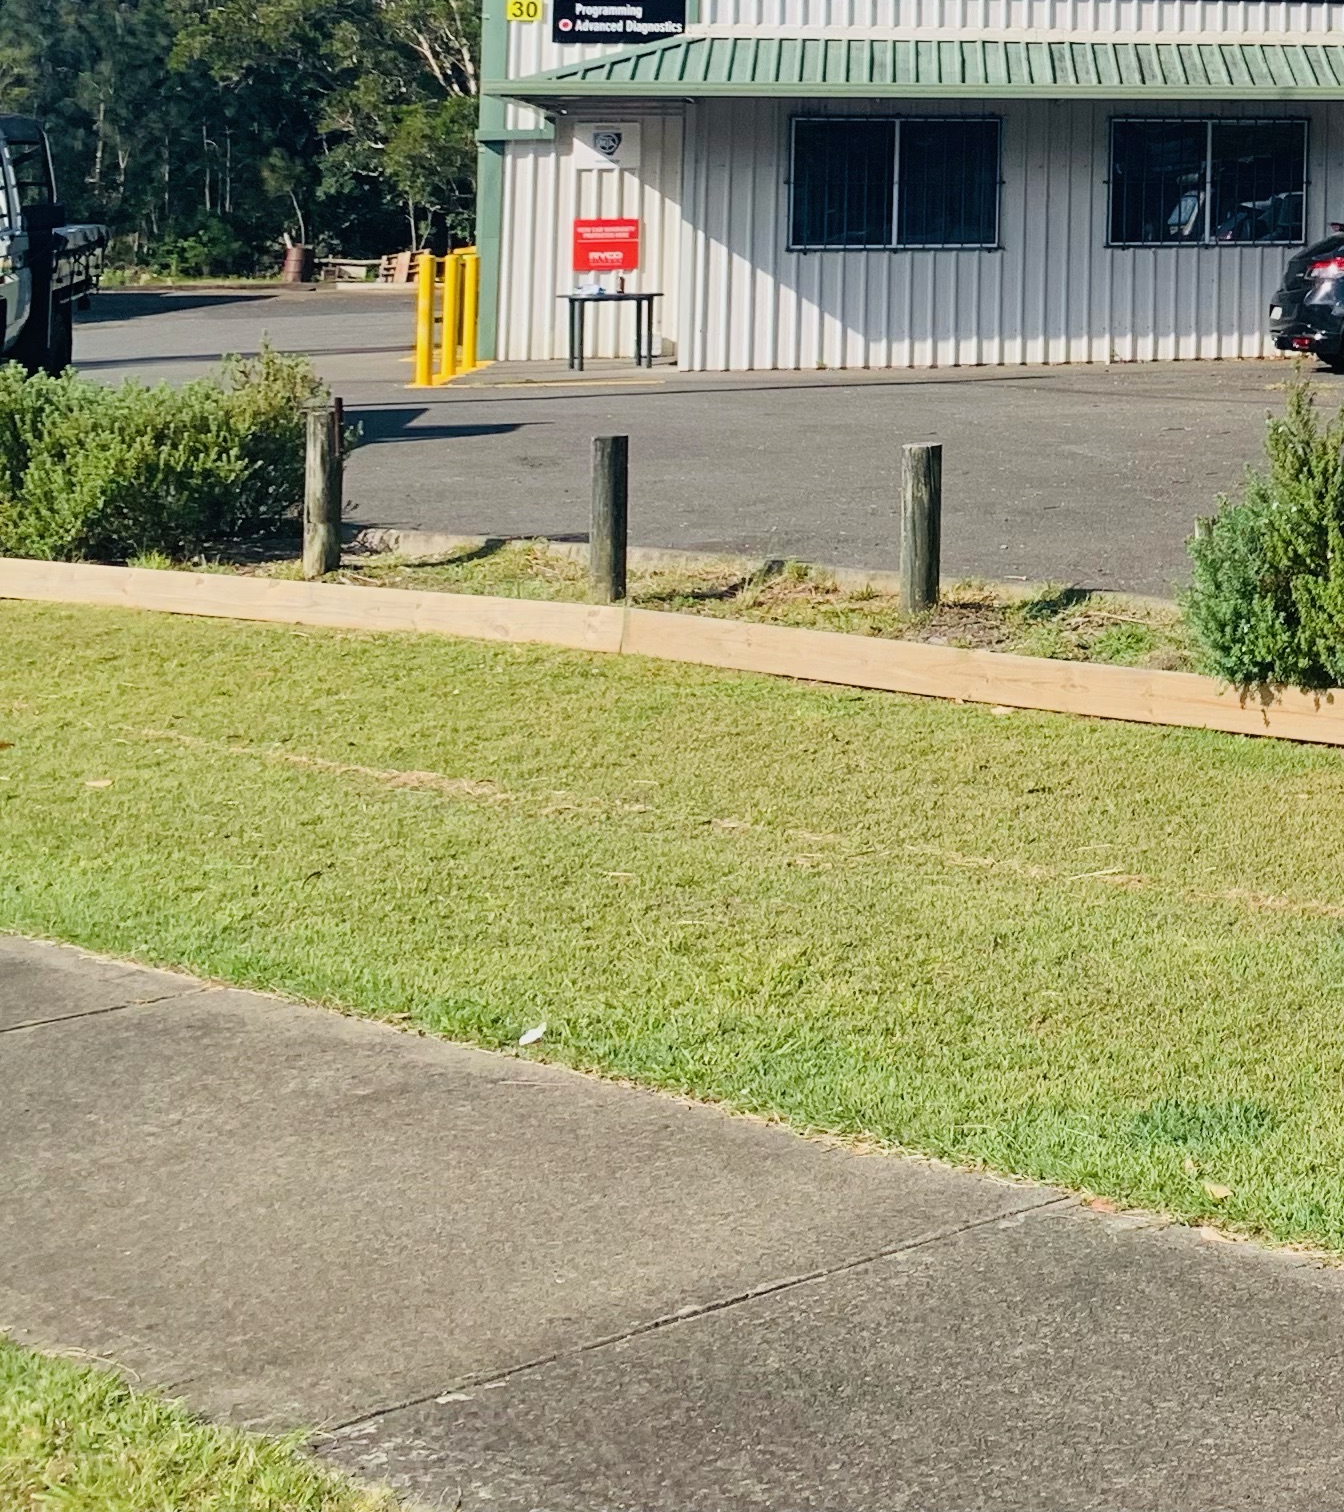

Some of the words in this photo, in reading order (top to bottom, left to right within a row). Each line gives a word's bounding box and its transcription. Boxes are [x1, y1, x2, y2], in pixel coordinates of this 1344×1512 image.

[512, 1, 538, 18] 30
[575, 4, 642, 18] Programming
[575, 20, 623, 33] Advanced
[626, 20, 682, 35] Diagnostics
